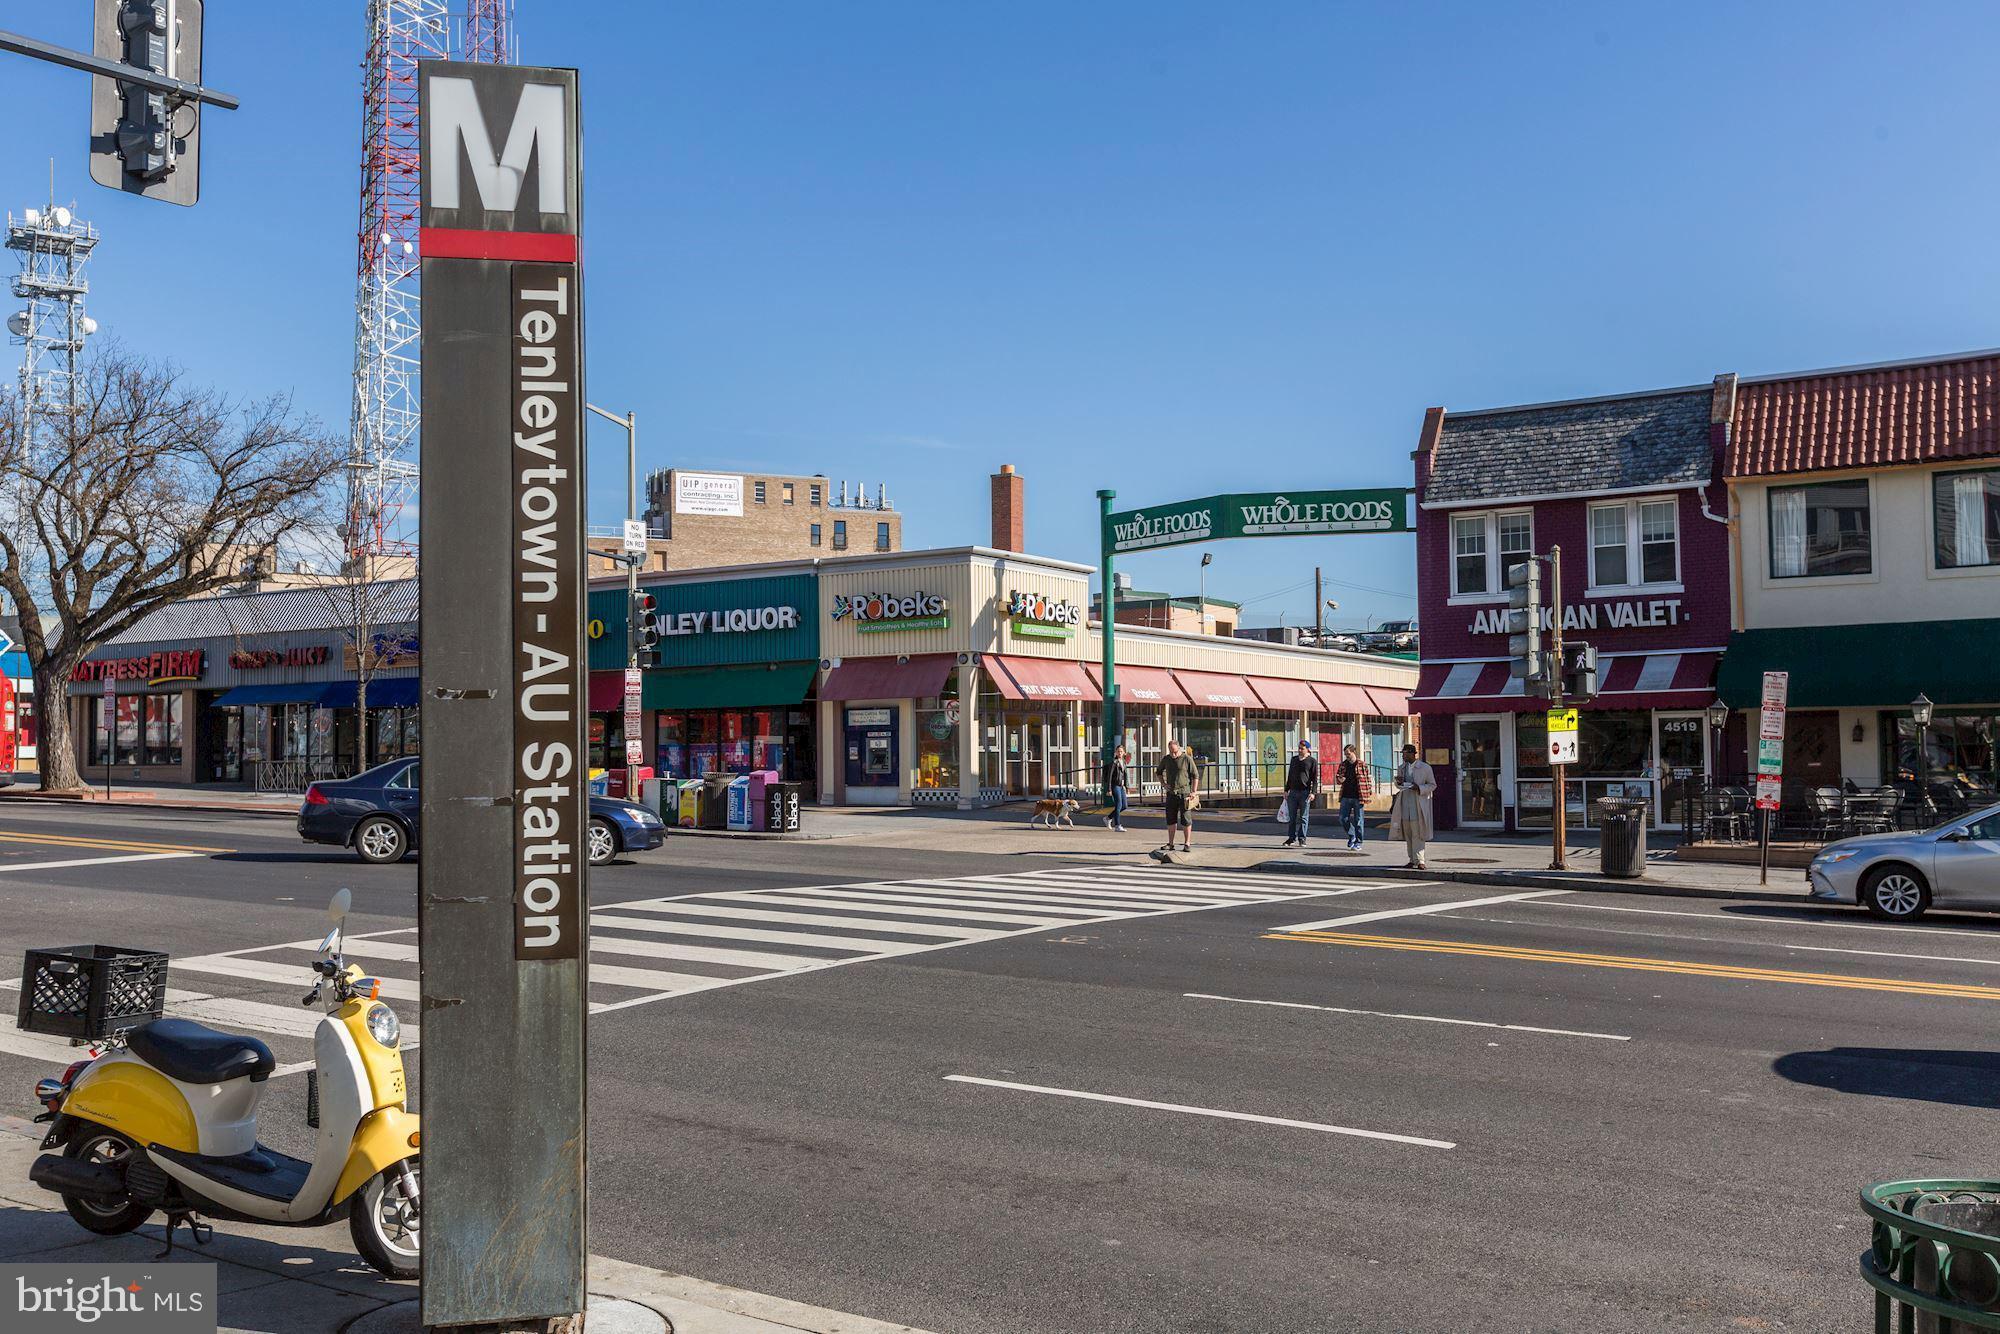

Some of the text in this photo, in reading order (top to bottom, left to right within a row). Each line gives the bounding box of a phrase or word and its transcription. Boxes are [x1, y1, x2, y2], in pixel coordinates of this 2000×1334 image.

[429, 76, 566, 213] M
[683, 480, 699, 488] UIP
[1240, 496, 1393, 524] WHOLE FOODS
[629, 531, 642, 539] TURN
[1114, 509, 1211, 542] WHOLE FOODS
[1258, 521, 1379, 532] MARKET
[635, 540, 645, 548] RED
[712, 606, 797, 633] LIQUOR
[852, 591, 943, 620] Robeks
[1025, 594, 1080, 625] Robeks
[1472, 599, 1682, 635] AMICAN VALET
[1664, 721, 1697, 732] 4519
[771, 792, 781, 829] blade
[787, 792, 798, 830] blade
[522, 742, 573, 947] Station
